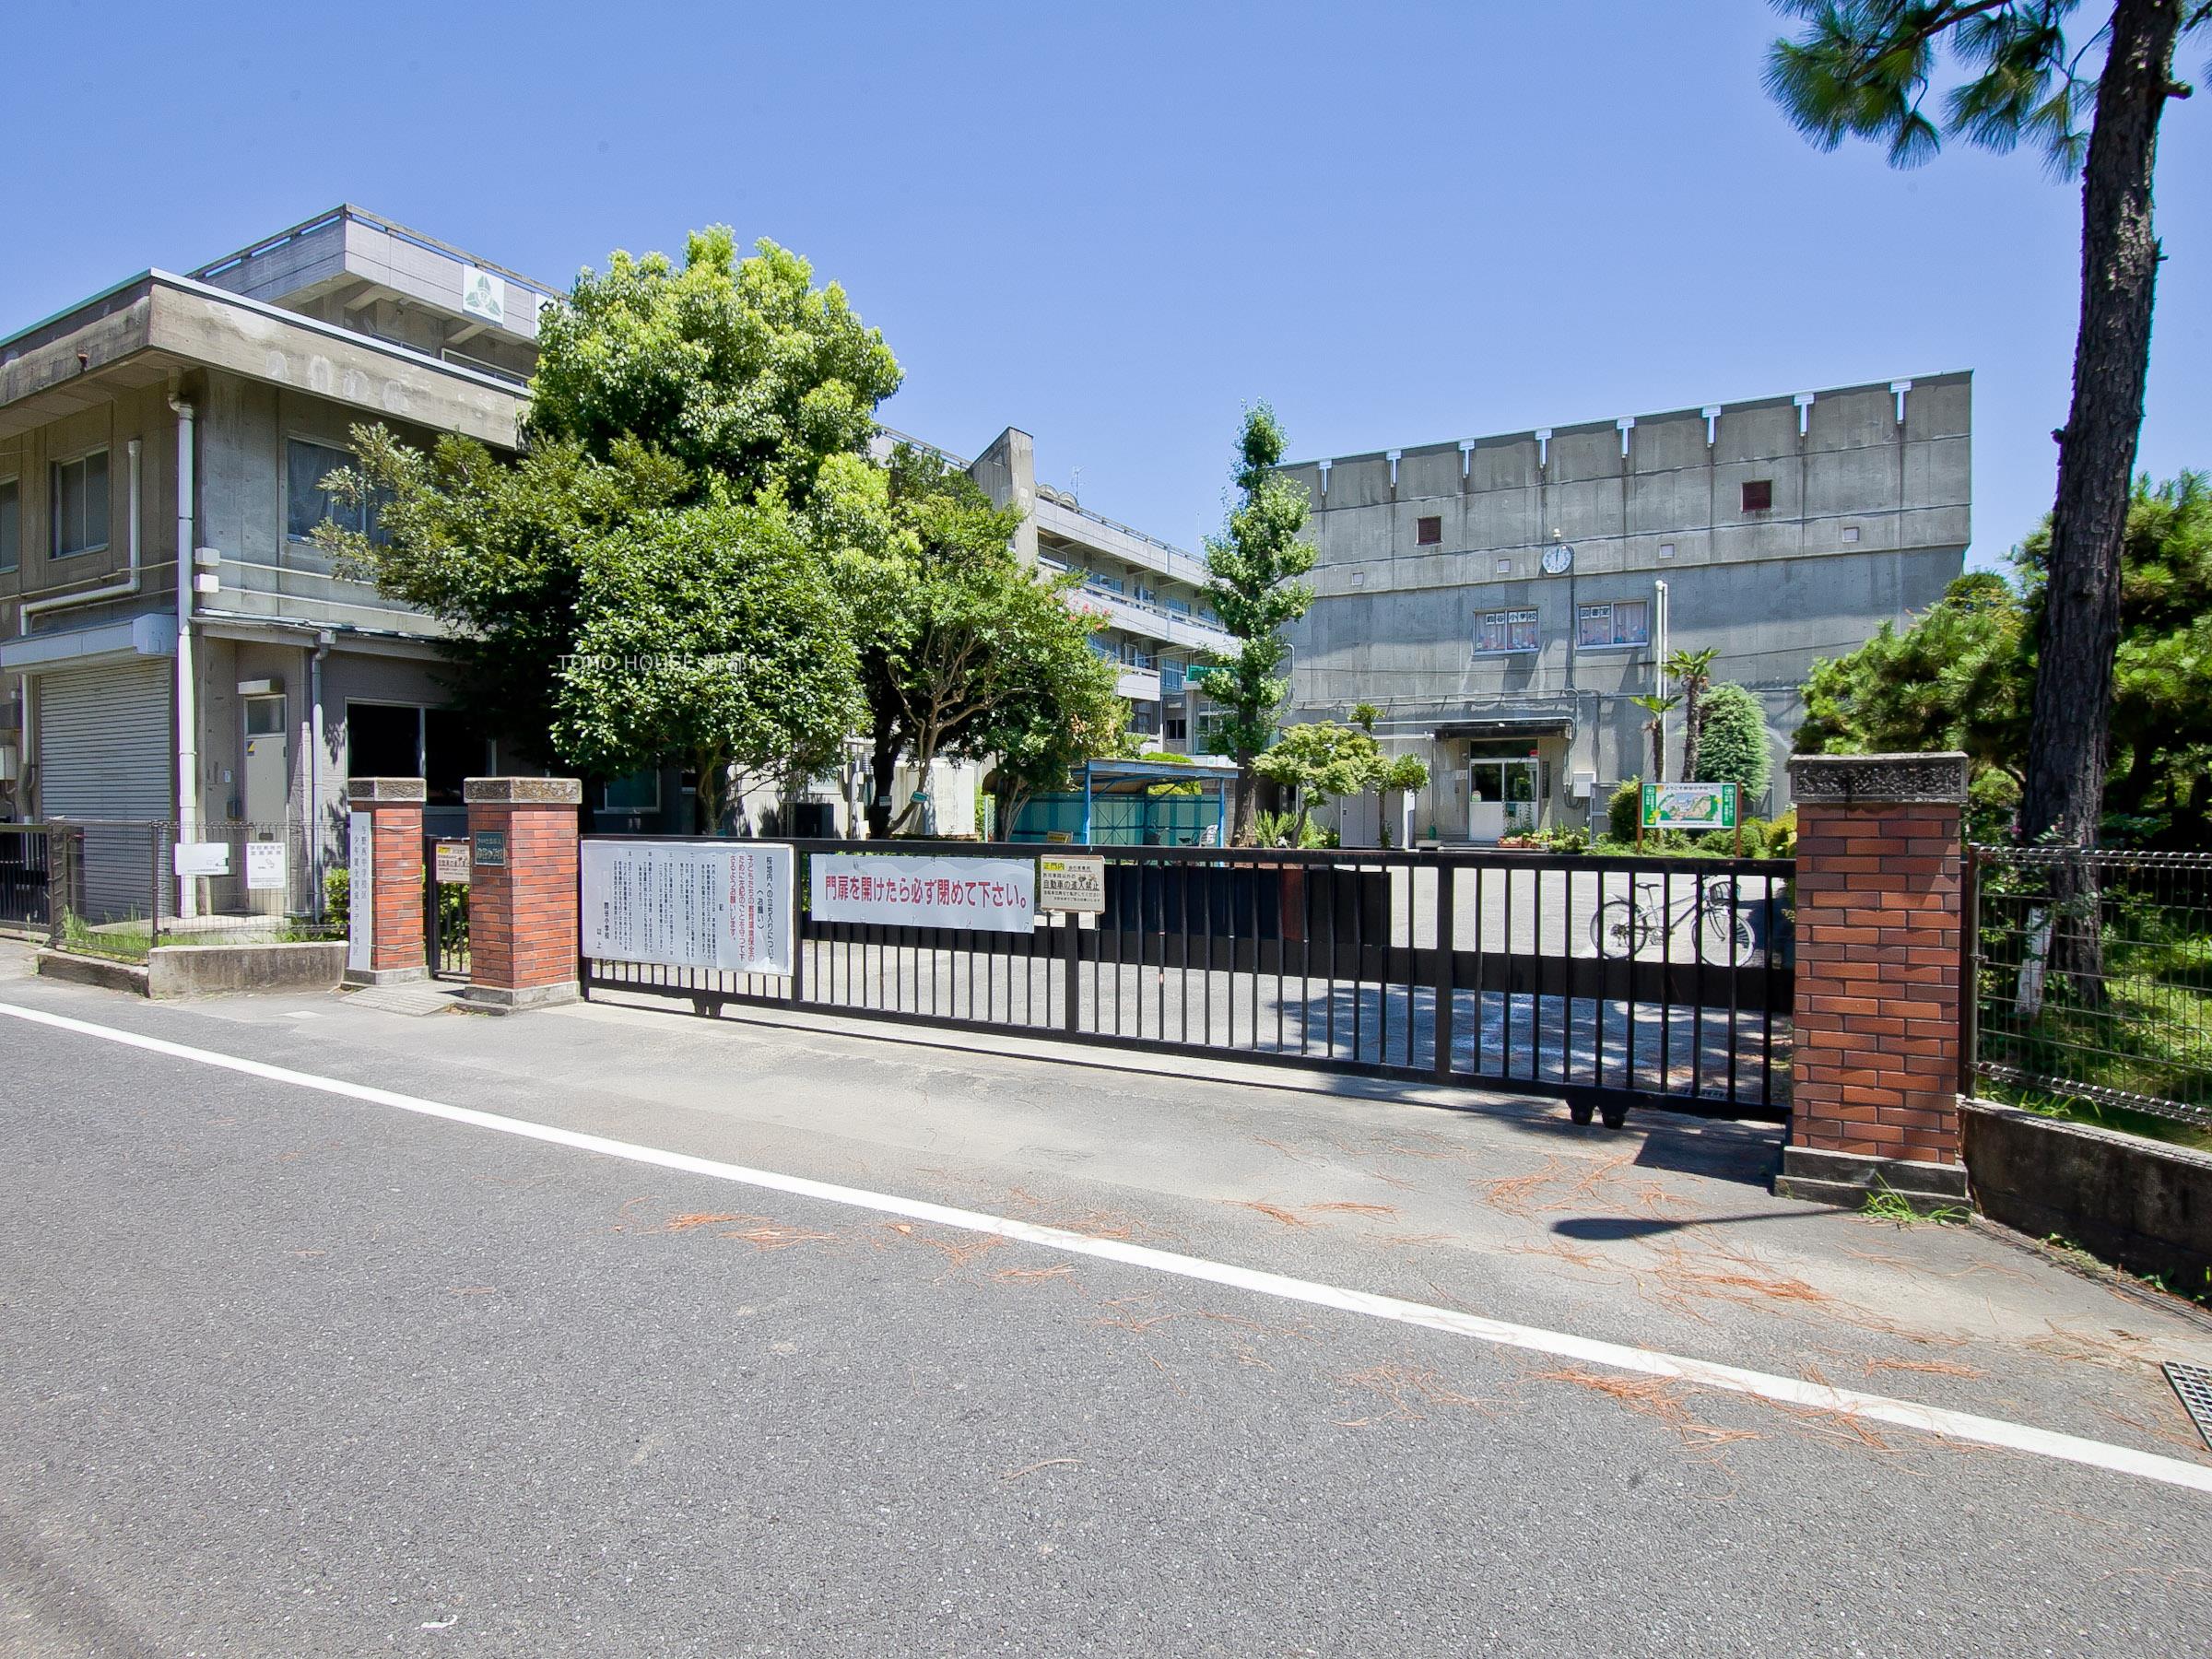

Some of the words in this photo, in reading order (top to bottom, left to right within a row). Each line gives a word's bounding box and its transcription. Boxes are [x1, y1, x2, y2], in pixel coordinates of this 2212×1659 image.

[1042, 862, 1065, 870] 正門内
[1043, 879, 1100, 891] 自動車の進入禁止
[825, 875, 1028, 909] 門扉を開けたら必ず閉めて下さい。
